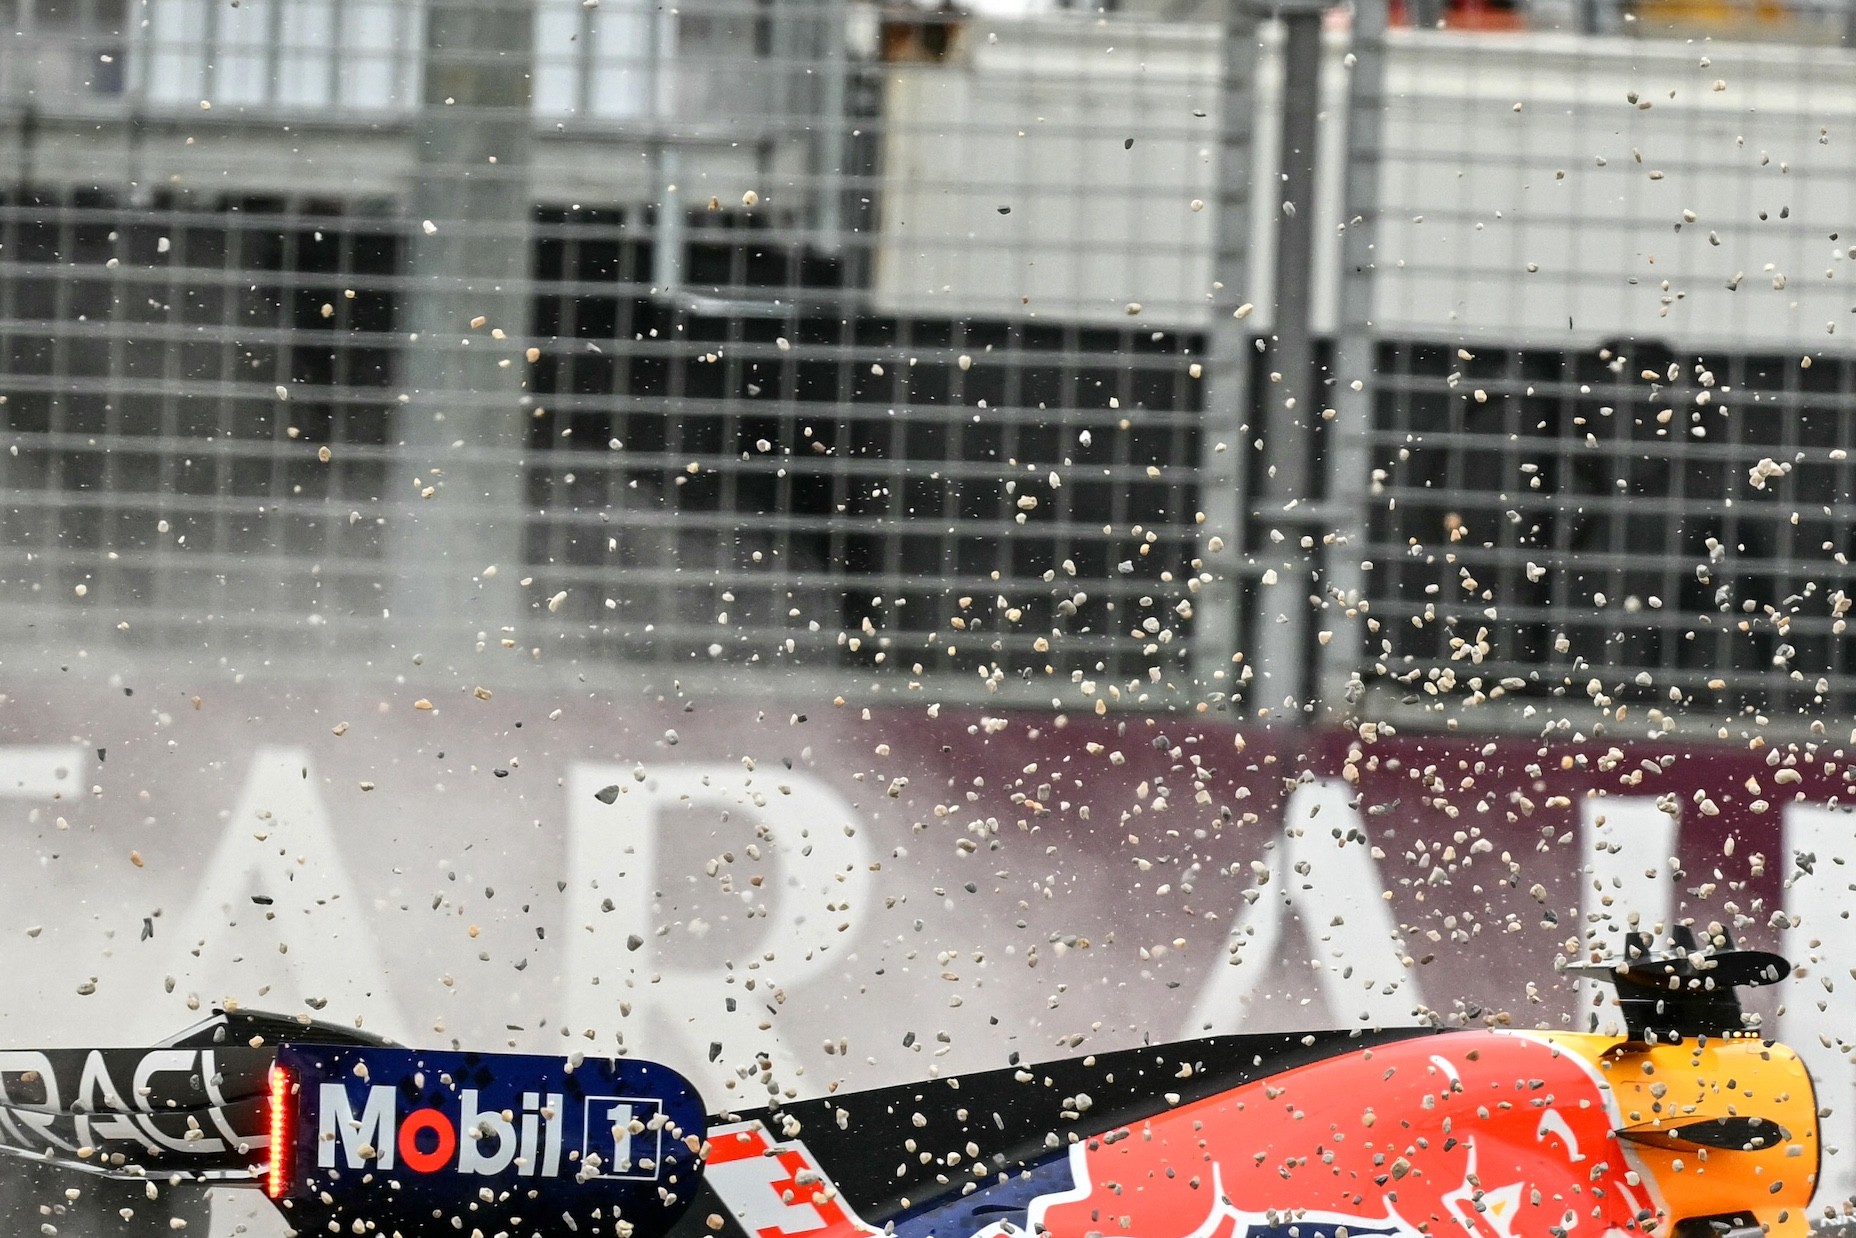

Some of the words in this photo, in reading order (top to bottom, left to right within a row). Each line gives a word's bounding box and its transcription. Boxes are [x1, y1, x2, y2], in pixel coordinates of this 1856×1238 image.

[0, 745, 872, 1110] AR
[0, 1050, 276, 1152] RACL
[318, 1083, 563, 1175] Mobil
[607, 1104, 632, 1172] 1
